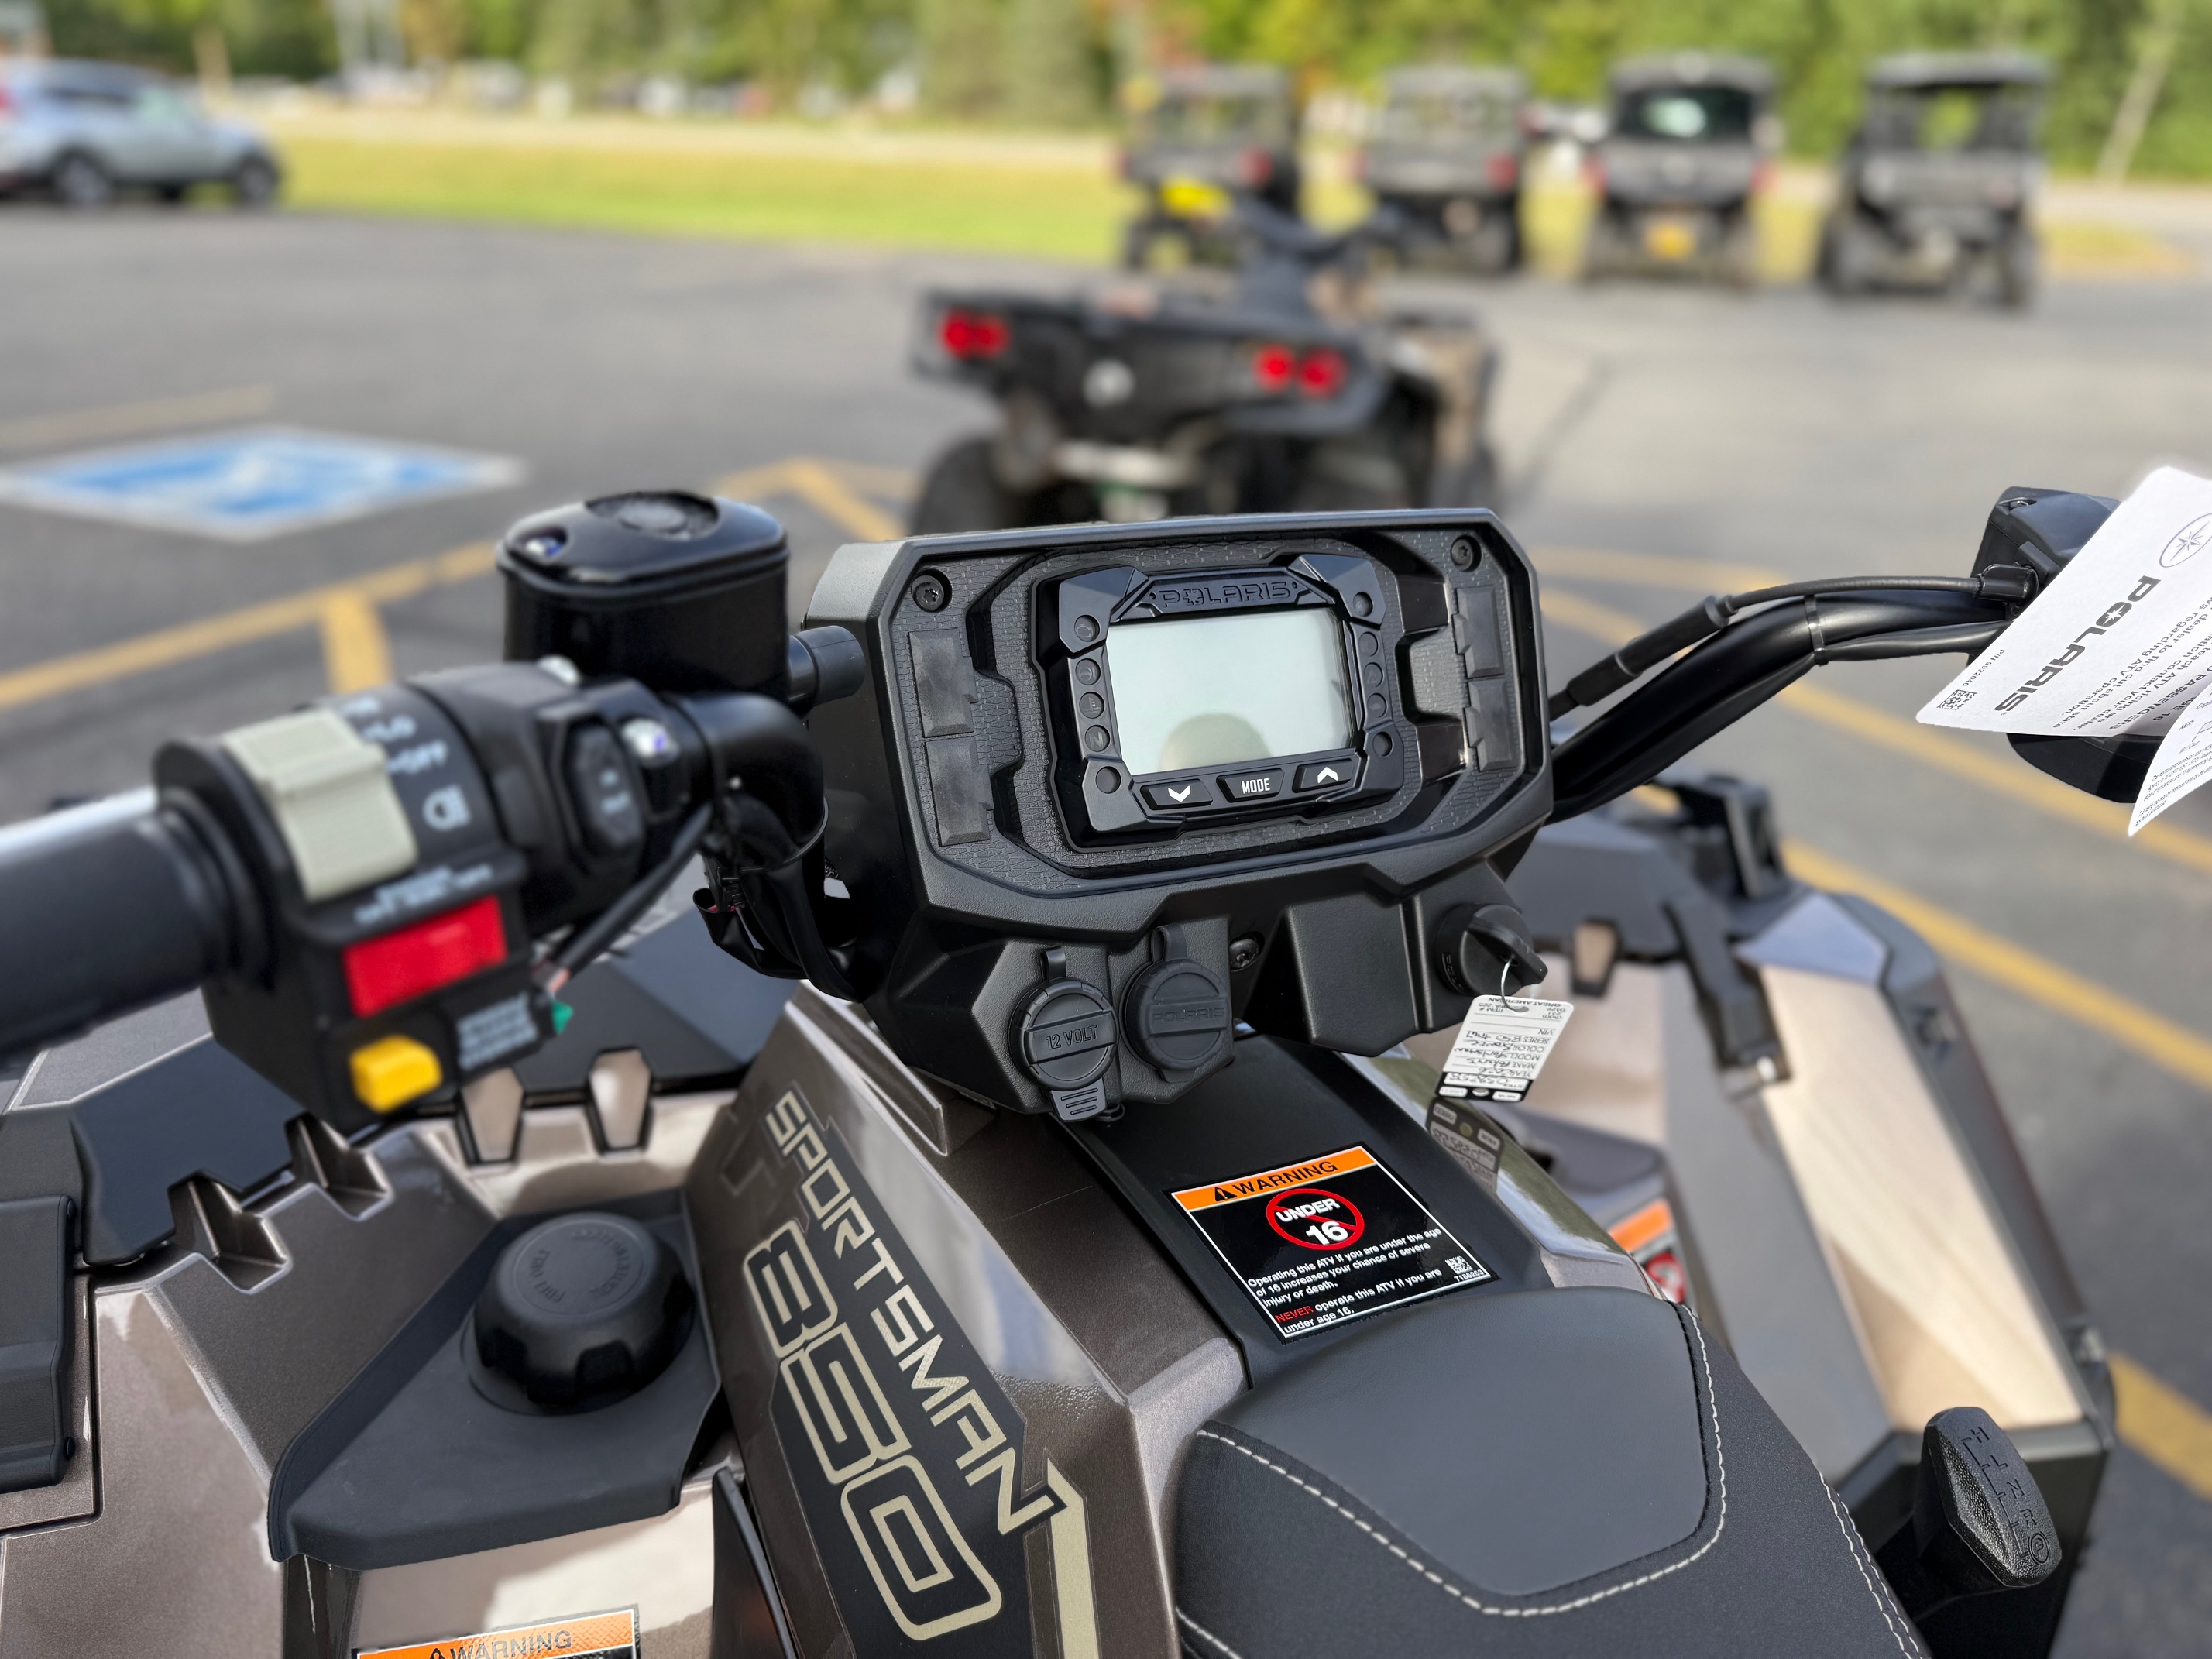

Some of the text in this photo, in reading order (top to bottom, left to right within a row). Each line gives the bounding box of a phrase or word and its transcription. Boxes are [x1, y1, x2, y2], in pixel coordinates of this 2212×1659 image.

[1162, 581, 1291, 607] POLARIS
[1994, 575, 2162, 712] POLARIS
[2142, 613, 2198, 656] regarding
[1990, 649, 2005, 661] P/N
[2121, 658, 2142, 676] ATV
[2177, 647, 2210, 671] teach
[2052, 613, 2208, 728] dealer to find out about state
[2138, 660, 2182, 689] contact
[2154, 672, 2176, 689] ATV
[2062, 678, 2117, 715] operation.
[2109, 674, 2207, 729] PASSENGERS
[2114, 691, 2139, 709] your
[2116, 690, 2151, 711] riding
[2073, 709, 2111, 730] dealer.
[1241, 778, 1271, 794] MODE
[1046, 1025, 1099, 1050] 12 VOLT
[1510, 1052, 1540, 1060] MODEL
[1231, 1160, 1339, 1195] WARNING
[1275, 1197, 1341, 1223] UNDER
[1306, 1221, 1348, 1245] 16
[1248, 1228, 1442, 1287] Operating this ATV if you are under the age
[1256, 1242, 1431, 1297] of 16 increases your chance of severe
[1262, 1280, 1338, 1308] injury or death.
[1275, 1269, 1443, 1323] NEVER operate this ATV if you are
[765, 1091, 1054, 1536] SPORTSMAN
[1284, 1307, 1355, 1334] under age 16.
[743, 1220, 1002, 1641] 850
[1970, 1426, 1990, 1444] H
[1990, 1455, 2008, 1471] L
[2007, 1479, 2025, 1499] N
[2020, 1508, 2037, 1529] R
[449, 1630, 572, 1659] WARNING
